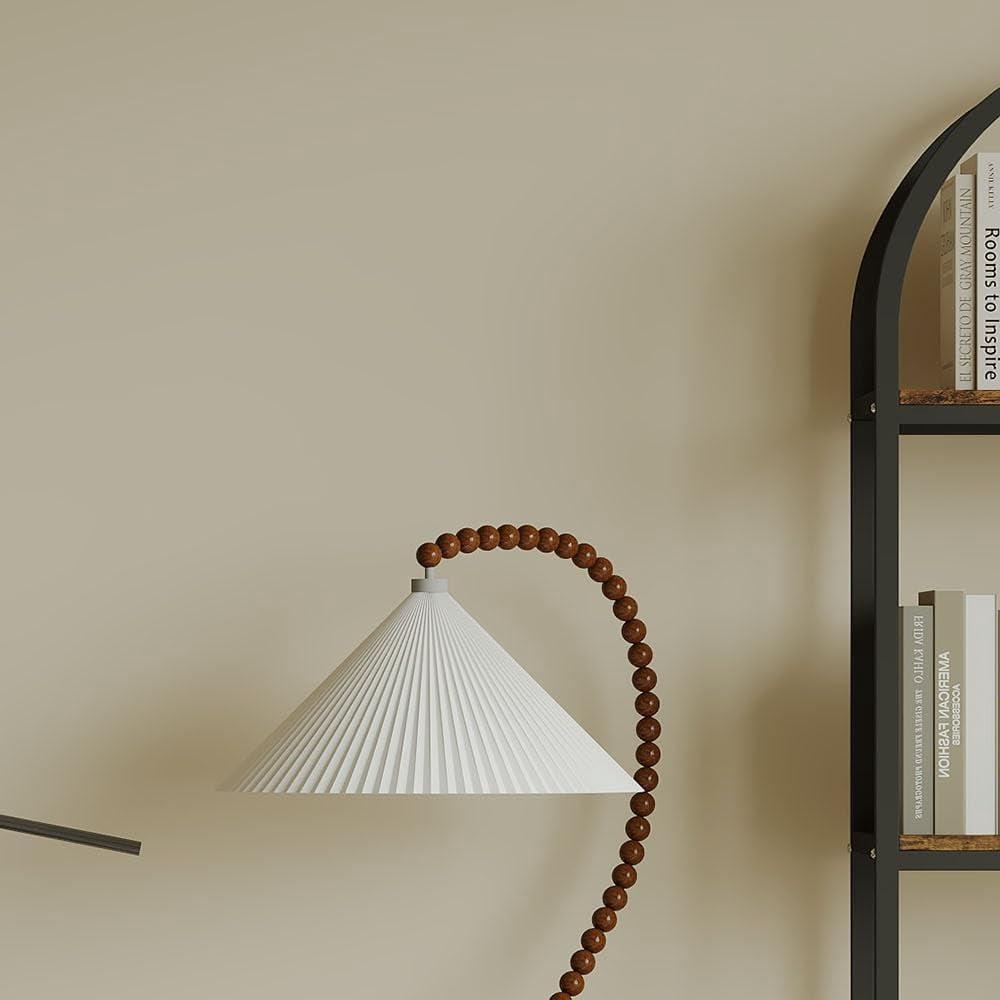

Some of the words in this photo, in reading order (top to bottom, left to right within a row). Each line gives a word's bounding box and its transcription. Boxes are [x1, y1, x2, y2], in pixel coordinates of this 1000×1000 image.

[959, 188, 972, 259] MOUNTAIN
[985, 227, 1000, 288] Rooms
[959, 259, 972, 290] GRAY
[959, 297, 972, 314] DE
[985, 294, 1000, 312] to
[980, 319, 1000, 381] Inspire
[959, 372, 972, 383] EL
